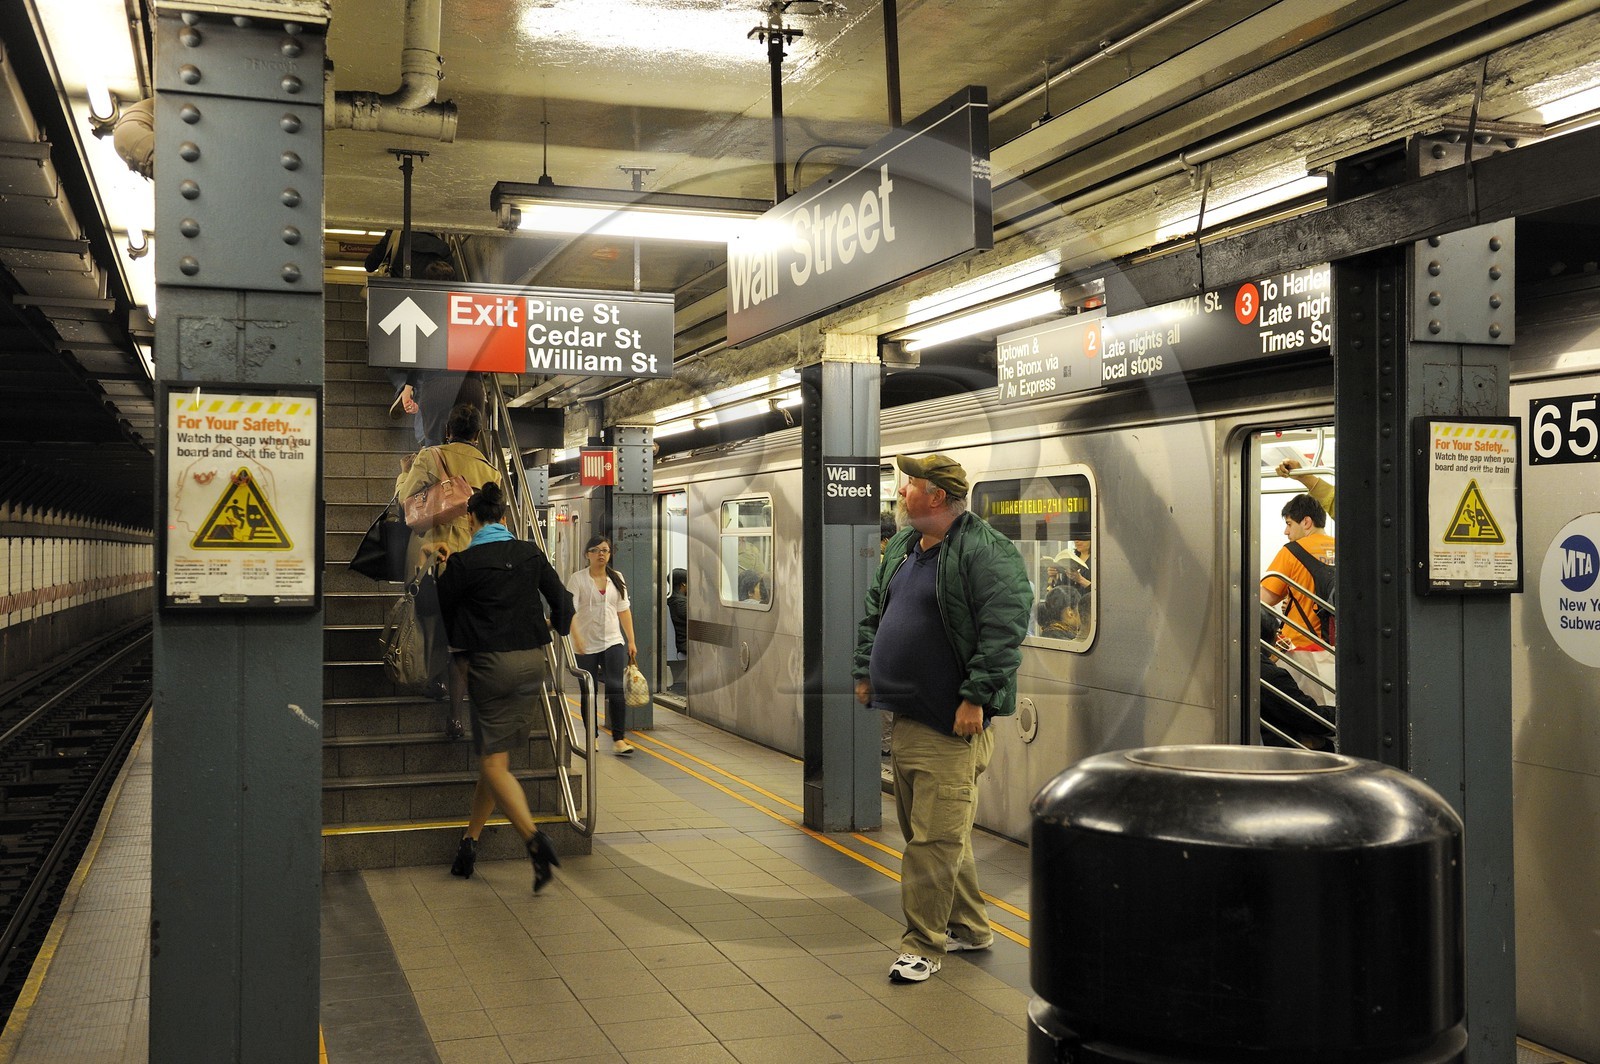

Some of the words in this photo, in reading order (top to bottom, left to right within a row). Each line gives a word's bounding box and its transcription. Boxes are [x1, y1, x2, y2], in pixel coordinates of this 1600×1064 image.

[790, 163, 896, 286] Street
[1204, 291, 1222, 314] St.
[1260, 280, 1278, 302] To
[450, 295, 518, 328] Exit
[528, 300, 584, 322] Pine
[593, 303, 620, 325] St
[1241, 292, 1252, 316] 3
[1259, 305, 1292, 328] Late
[528, 324, 607, 348] Cedar
[615, 327, 641, 350] St
[1088, 331, 1096, 350] 2
[1102, 339, 1126, 360] Late
[1129, 330, 1163, 356] nights
[1167, 323, 1180, 345] all
[1259, 329, 1305, 353] Times
[528, 347, 622, 372] William
[631, 352, 658, 374] St
[997, 342, 1030, 363] Uptown
[1032, 337, 1040, 354] &
[998, 363, 1014, 381] The
[1016, 358, 1043, 376] Bronx
[1045, 354, 1059, 371] via
[1102, 357, 1128, 381] local
[1131, 353, 1163, 376] stops
[999, 383, 1004, 399] 7
[1007, 382, 1017, 399] Av
[1020, 376, 1056, 397] Express
[177, 415, 202, 429] For
[205, 416, 239, 430] Your
[243, 417, 301, 435] Safety...
[1533, 400, 1598, 458] 65
[177, 433, 212, 444] Watch
[215, 434, 232, 444] the
[236, 437, 256, 447] gap
[259, 436, 289, 446] when
[292, 439, 311, 449] you
[1435, 439, 1450, 449] For
[1453, 440, 1472, 451] Your
[1475, 441, 1509, 454] Safety...
[177, 446, 209, 458] board
[212, 447, 233, 458] and
[236, 449, 256, 459] exit
[259, 449, 276, 459] the
[280, 450, 304, 460] train
[1435, 452, 1456, 461] Watch
[1458, 453, 1469, 462] the
[1470, 455, 1482, 463] gap
[1484, 454, 1501, 463] when
[1503, 456, 1515, 464] you
[827, 467, 856, 480] Wall
[1435, 463, 1454, 472] board
[1456, 463, 1468, 472] and
[1470, 465, 1482, 473] exit
[1483, 465, 1493, 473] the
[1495, 466, 1510, 474] train
[827, 483, 872, 497] Street
[1067, 497, 1079, 513] ST
[1560, 548, 1593, 580] MTA
[1560, 597, 1587, 611] New
